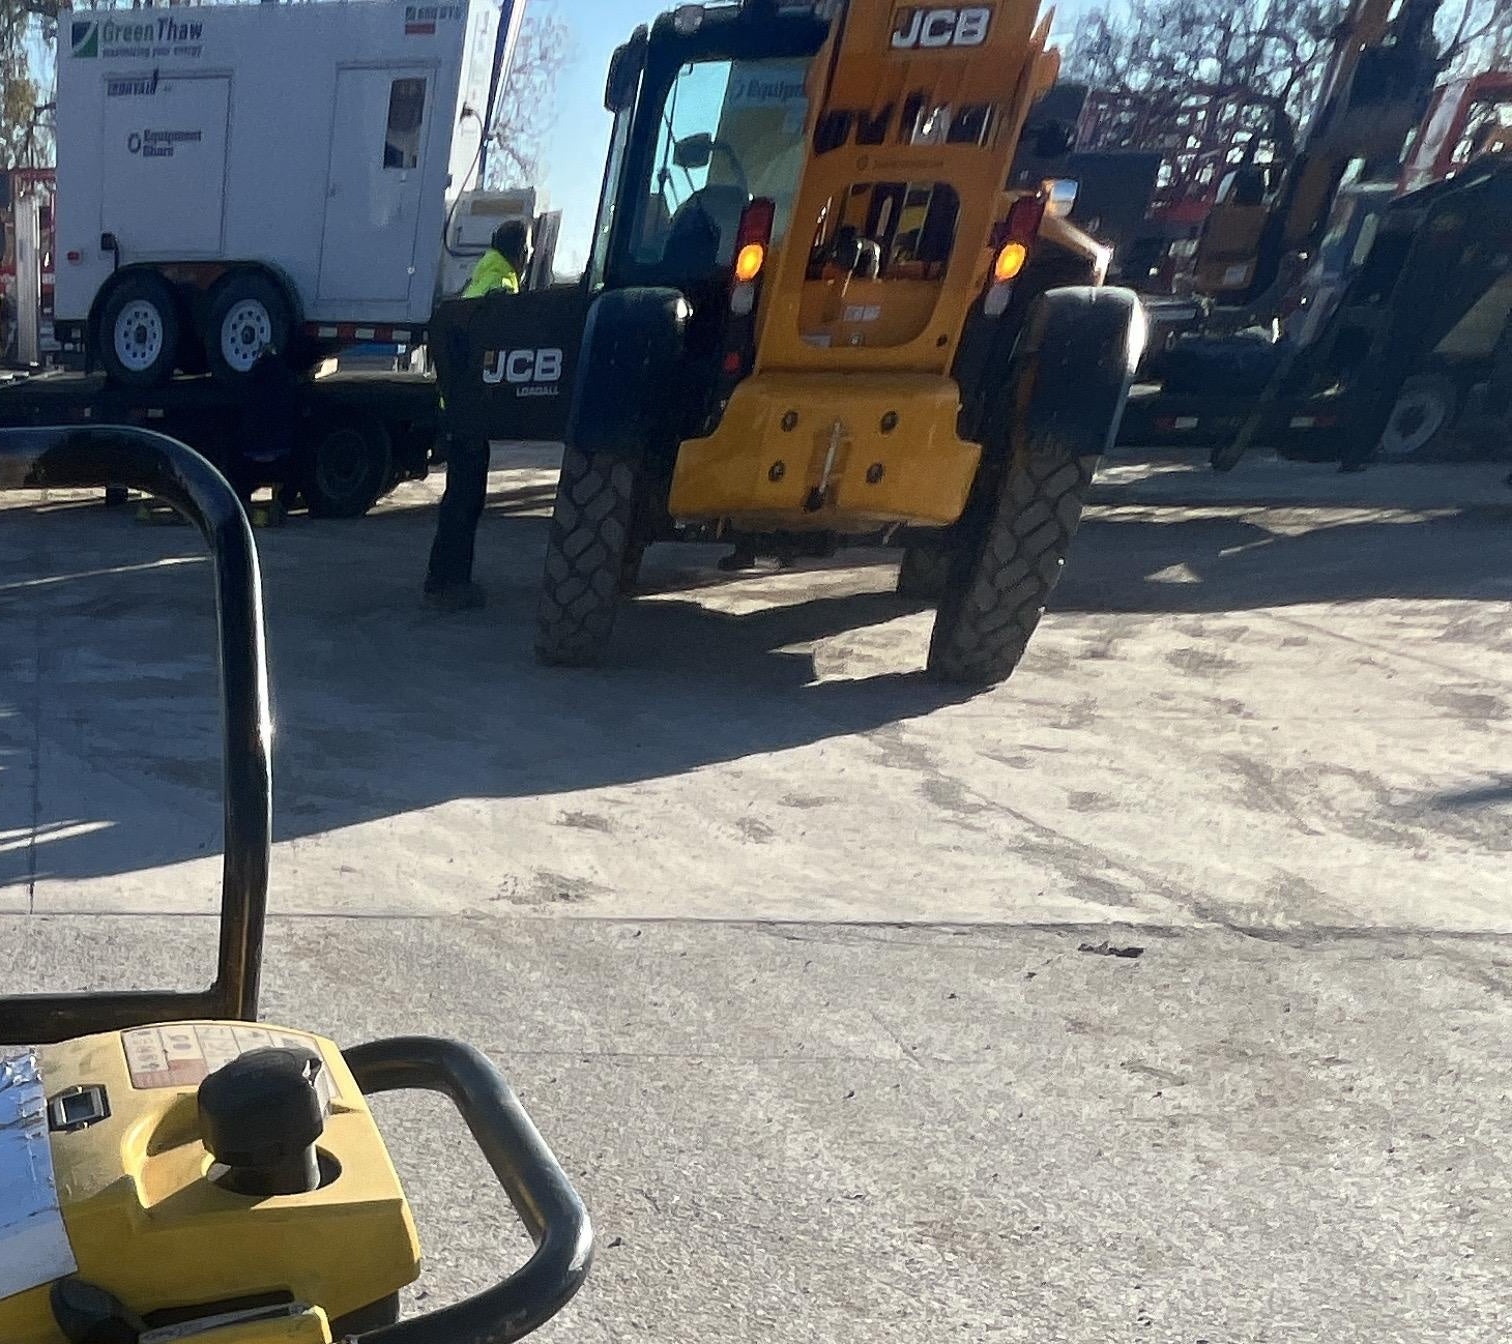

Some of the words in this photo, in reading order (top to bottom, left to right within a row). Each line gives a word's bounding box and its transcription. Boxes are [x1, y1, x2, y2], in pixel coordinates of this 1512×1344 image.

[891, 8, 991, 48] JCB
[482, 348, 563, 383] JCB
[516, 386, 559, 397] LOADALL
